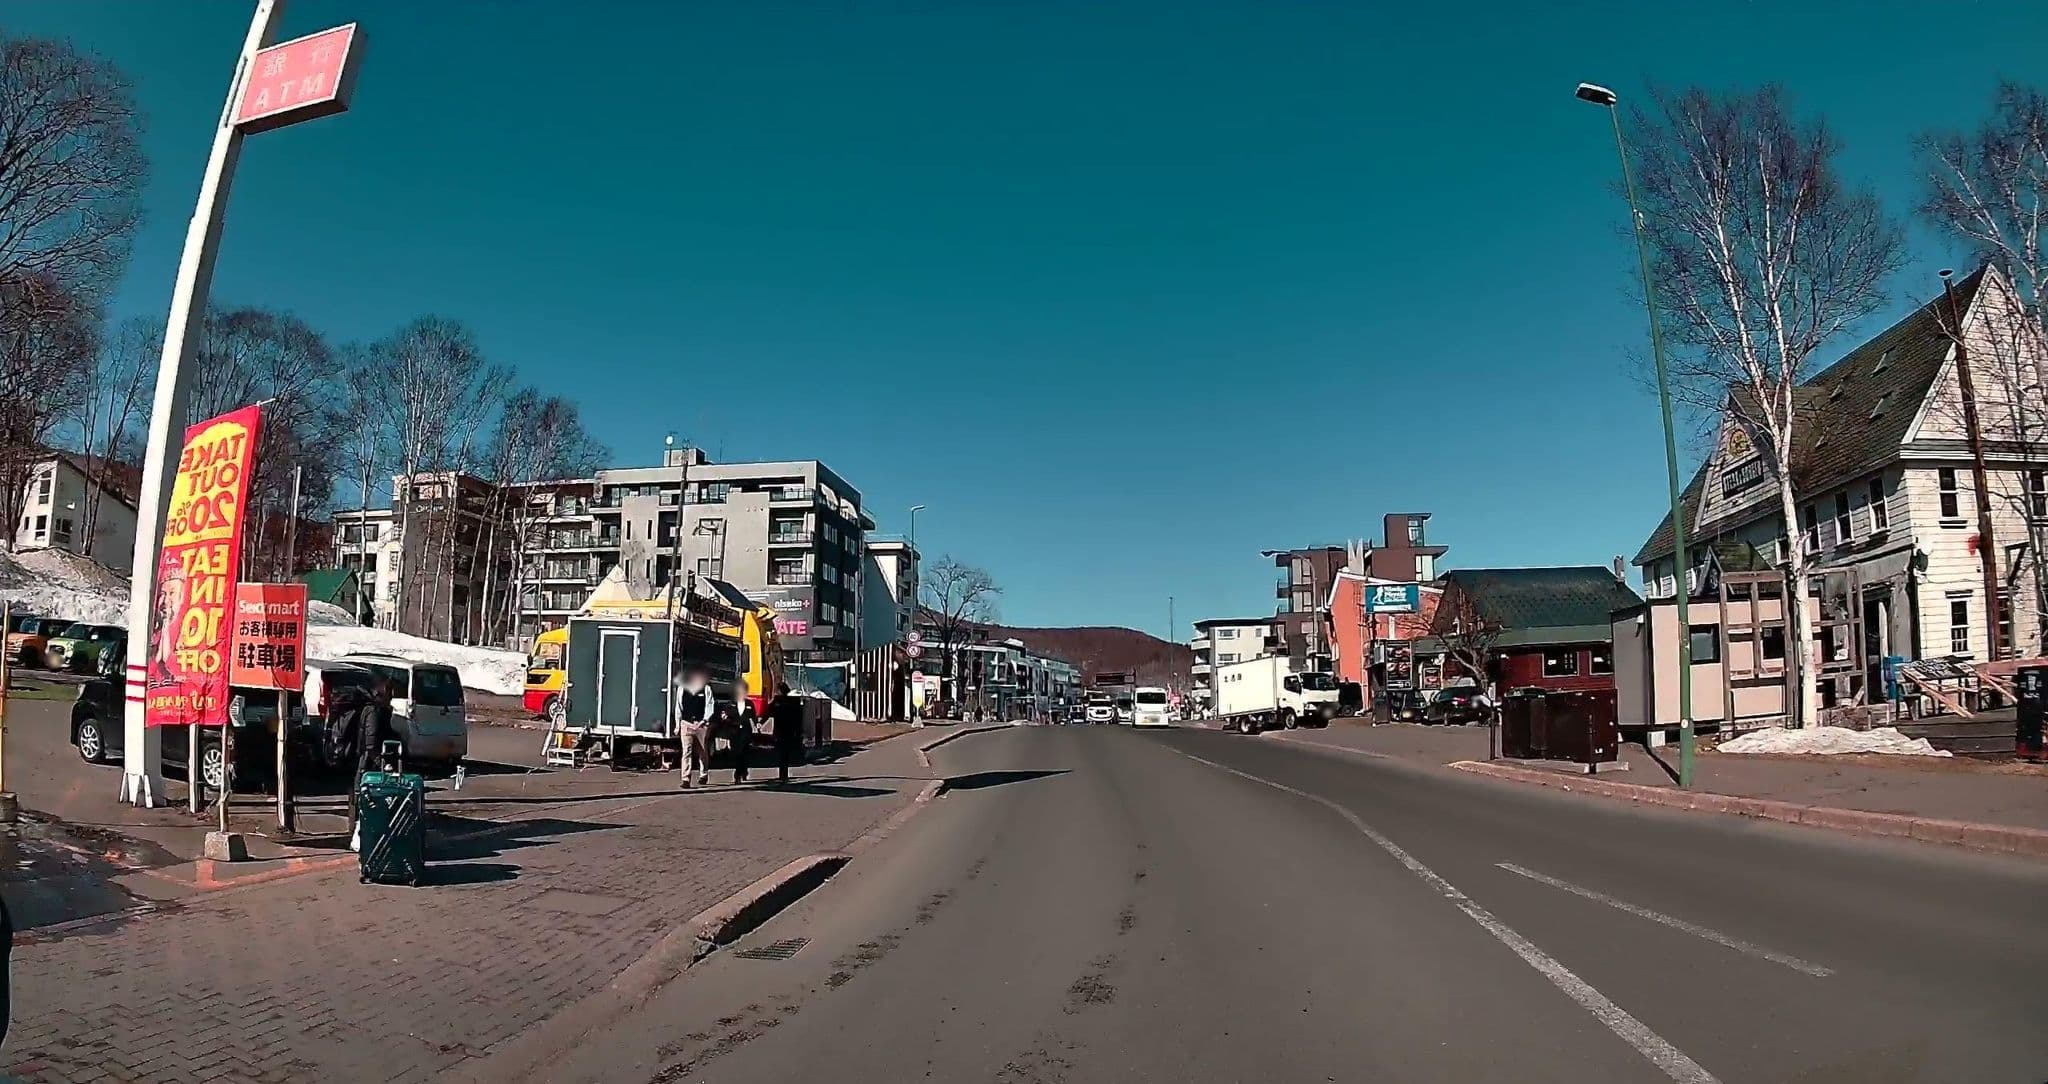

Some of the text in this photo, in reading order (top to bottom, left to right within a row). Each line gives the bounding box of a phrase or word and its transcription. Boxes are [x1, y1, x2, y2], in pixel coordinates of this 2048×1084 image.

[252, 72, 326, 112] ATM
[237, 642, 296, 672] 駐車場
